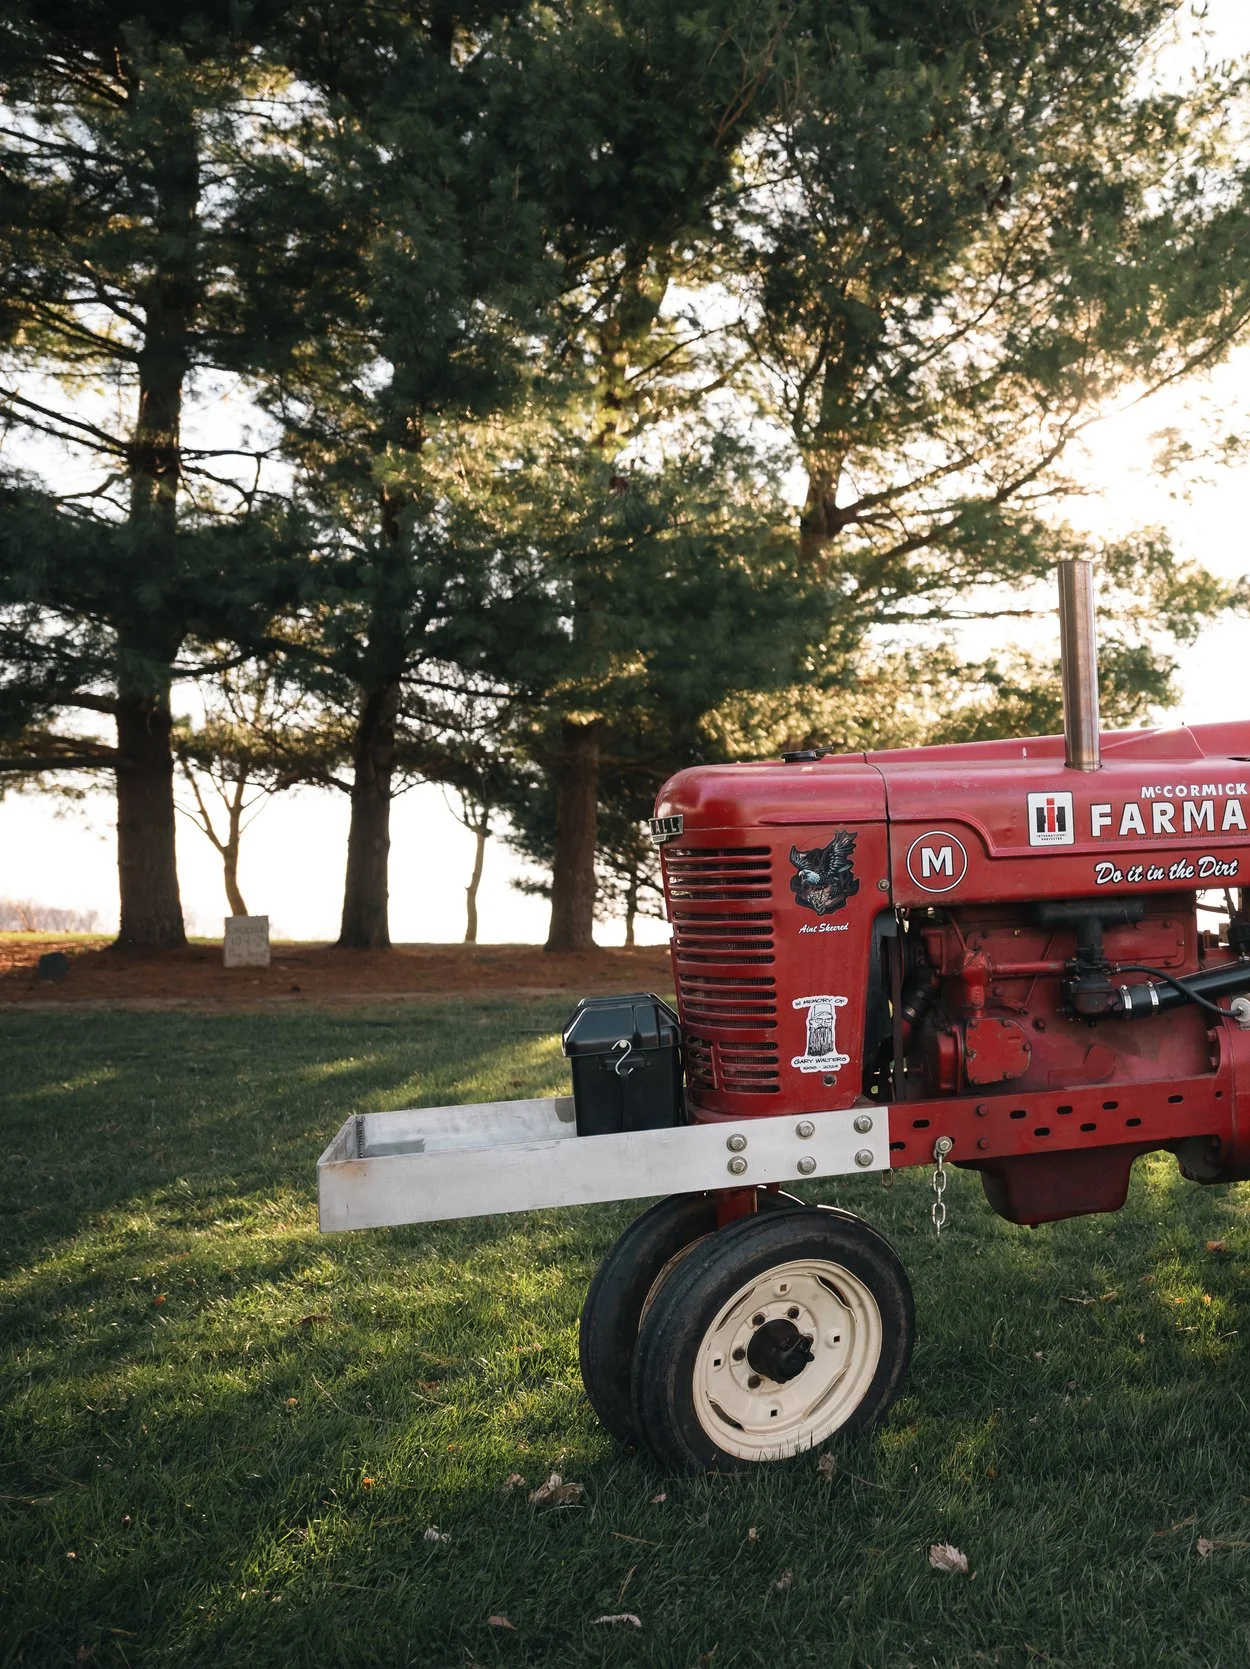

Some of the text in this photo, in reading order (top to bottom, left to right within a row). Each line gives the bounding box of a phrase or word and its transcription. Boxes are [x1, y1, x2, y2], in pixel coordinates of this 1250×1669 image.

[1141, 783, 1248, 799] McCORMICK
[921, 846, 954, 878] M
[1095, 855, 1239, 884] Do it in the Dirt
[799, 922, 849, 934] Aint Skeered
